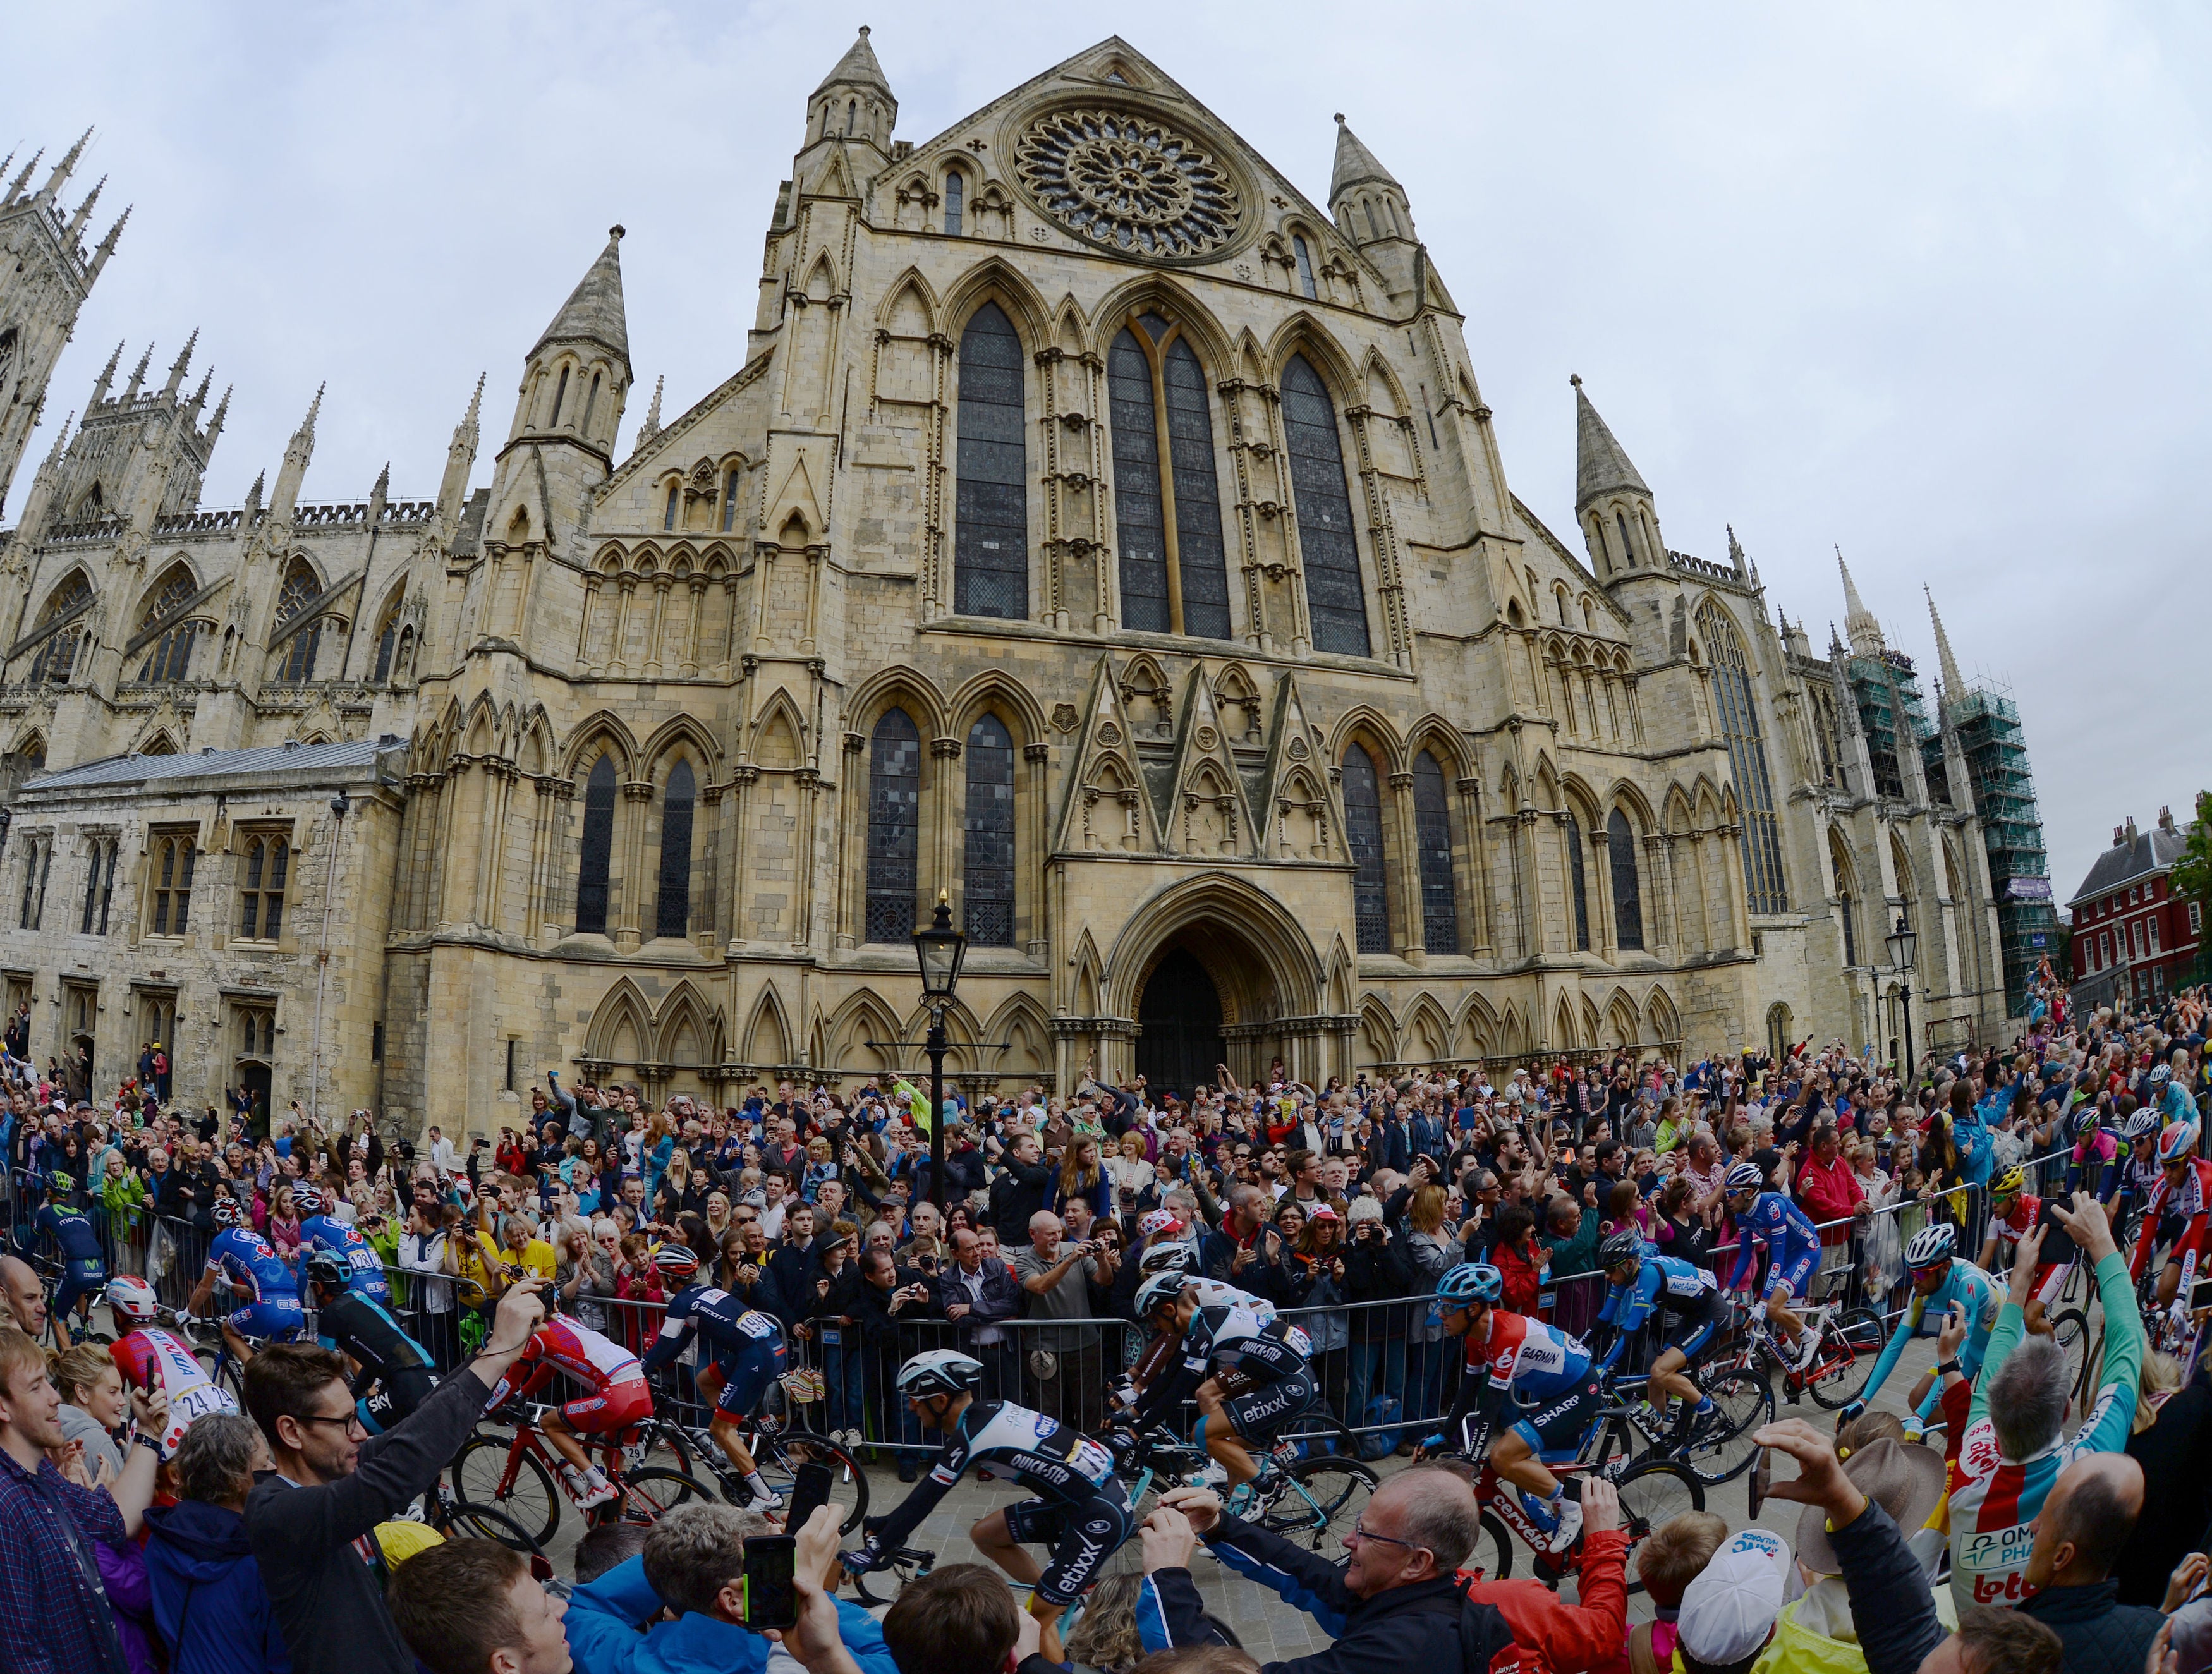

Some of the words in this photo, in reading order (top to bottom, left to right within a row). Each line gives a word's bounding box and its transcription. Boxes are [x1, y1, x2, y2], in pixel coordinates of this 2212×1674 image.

[351, 1254, 371, 1269] 128
[1670, 1282, 1698, 1292] NetApp
[698, 1306, 731, 1323] SCOTT
[1521, 1347, 1560, 1365] GARMIN
[183, 1392, 209, 1418] 24
[717, 1382, 734, 1405] IAM
[1533, 1395, 1580, 1428] SHARP
[1631, 1415, 1661, 1443] UJI
[629, 1448, 640, 1458] 29
[1076, 1446, 1105, 1473] 73
[1282, 1449, 1294, 1462] 75
[1010, 1454, 1071, 1485] QUICK-STEP
[1493, 1495, 1548, 1551] cervélo
[1742, 1533, 1778, 1546] HALFORDS
[1058, 1527, 1103, 1592] etixx
